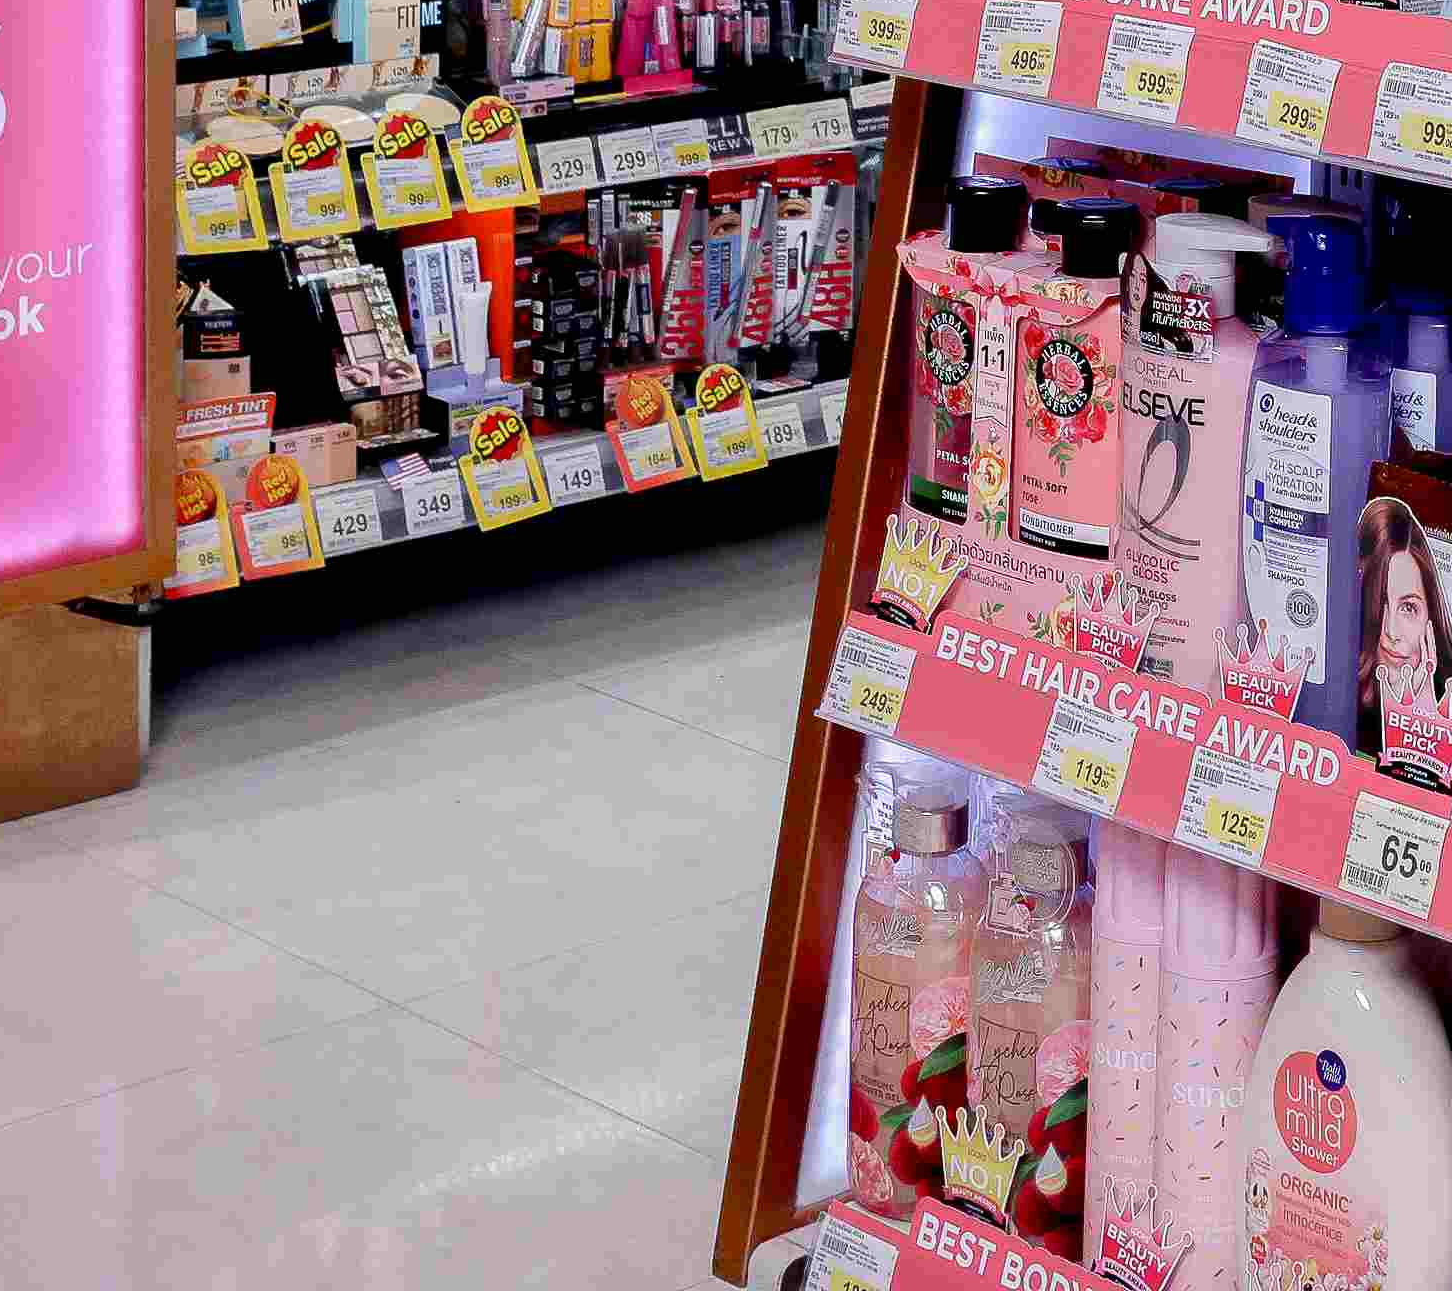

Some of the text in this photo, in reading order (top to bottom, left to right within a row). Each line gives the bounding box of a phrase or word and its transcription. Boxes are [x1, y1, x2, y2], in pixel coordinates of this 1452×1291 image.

[290, 124, 338, 169] Sale
[183, 395, 270, 421] FRESH TINT
[936, 624, 1344, 789] BEST HAIR CARE AWARD
[1279, 1170, 1352, 1213] ORGANIC
[917, 1208, 1000, 1275] BEST
